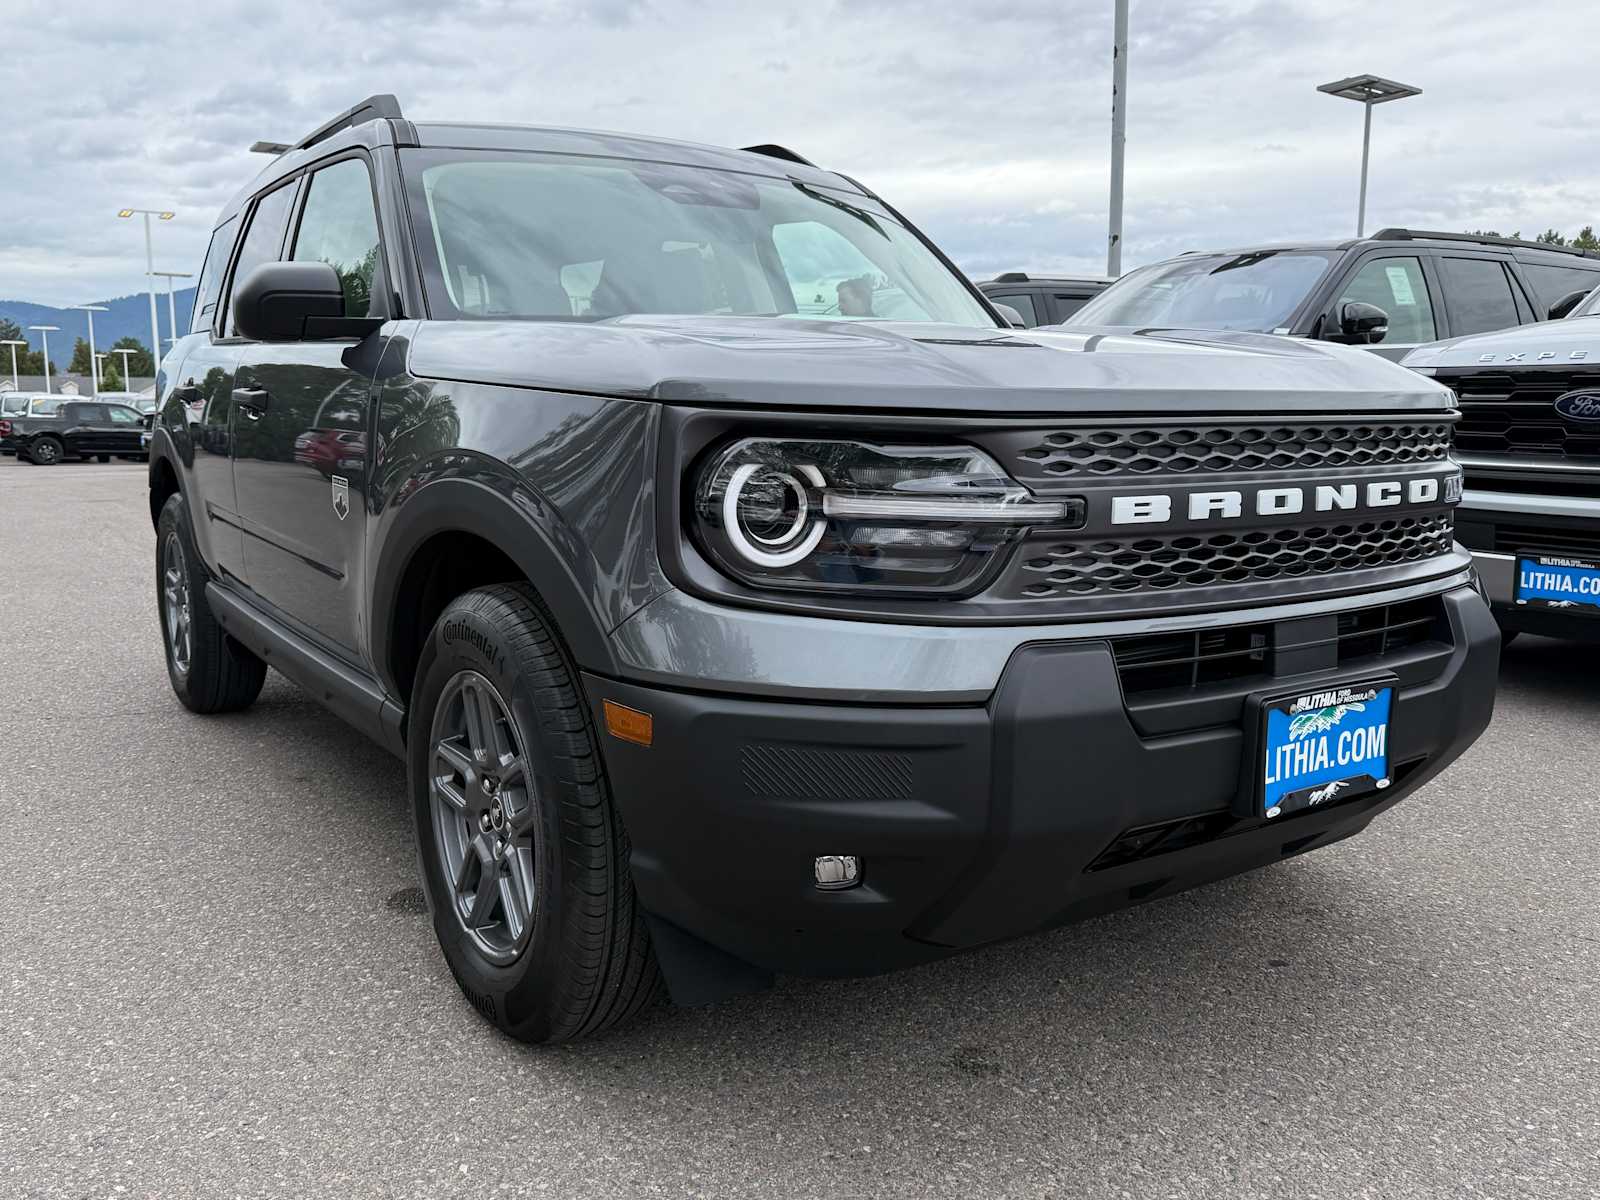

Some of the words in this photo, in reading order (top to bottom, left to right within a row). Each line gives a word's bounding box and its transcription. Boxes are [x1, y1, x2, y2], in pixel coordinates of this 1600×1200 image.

[1111, 478, 1439, 525] BRONCO
[1305, 691, 1336, 710] LITHIA
[1265, 724, 1386, 784] LITHIA.COM
